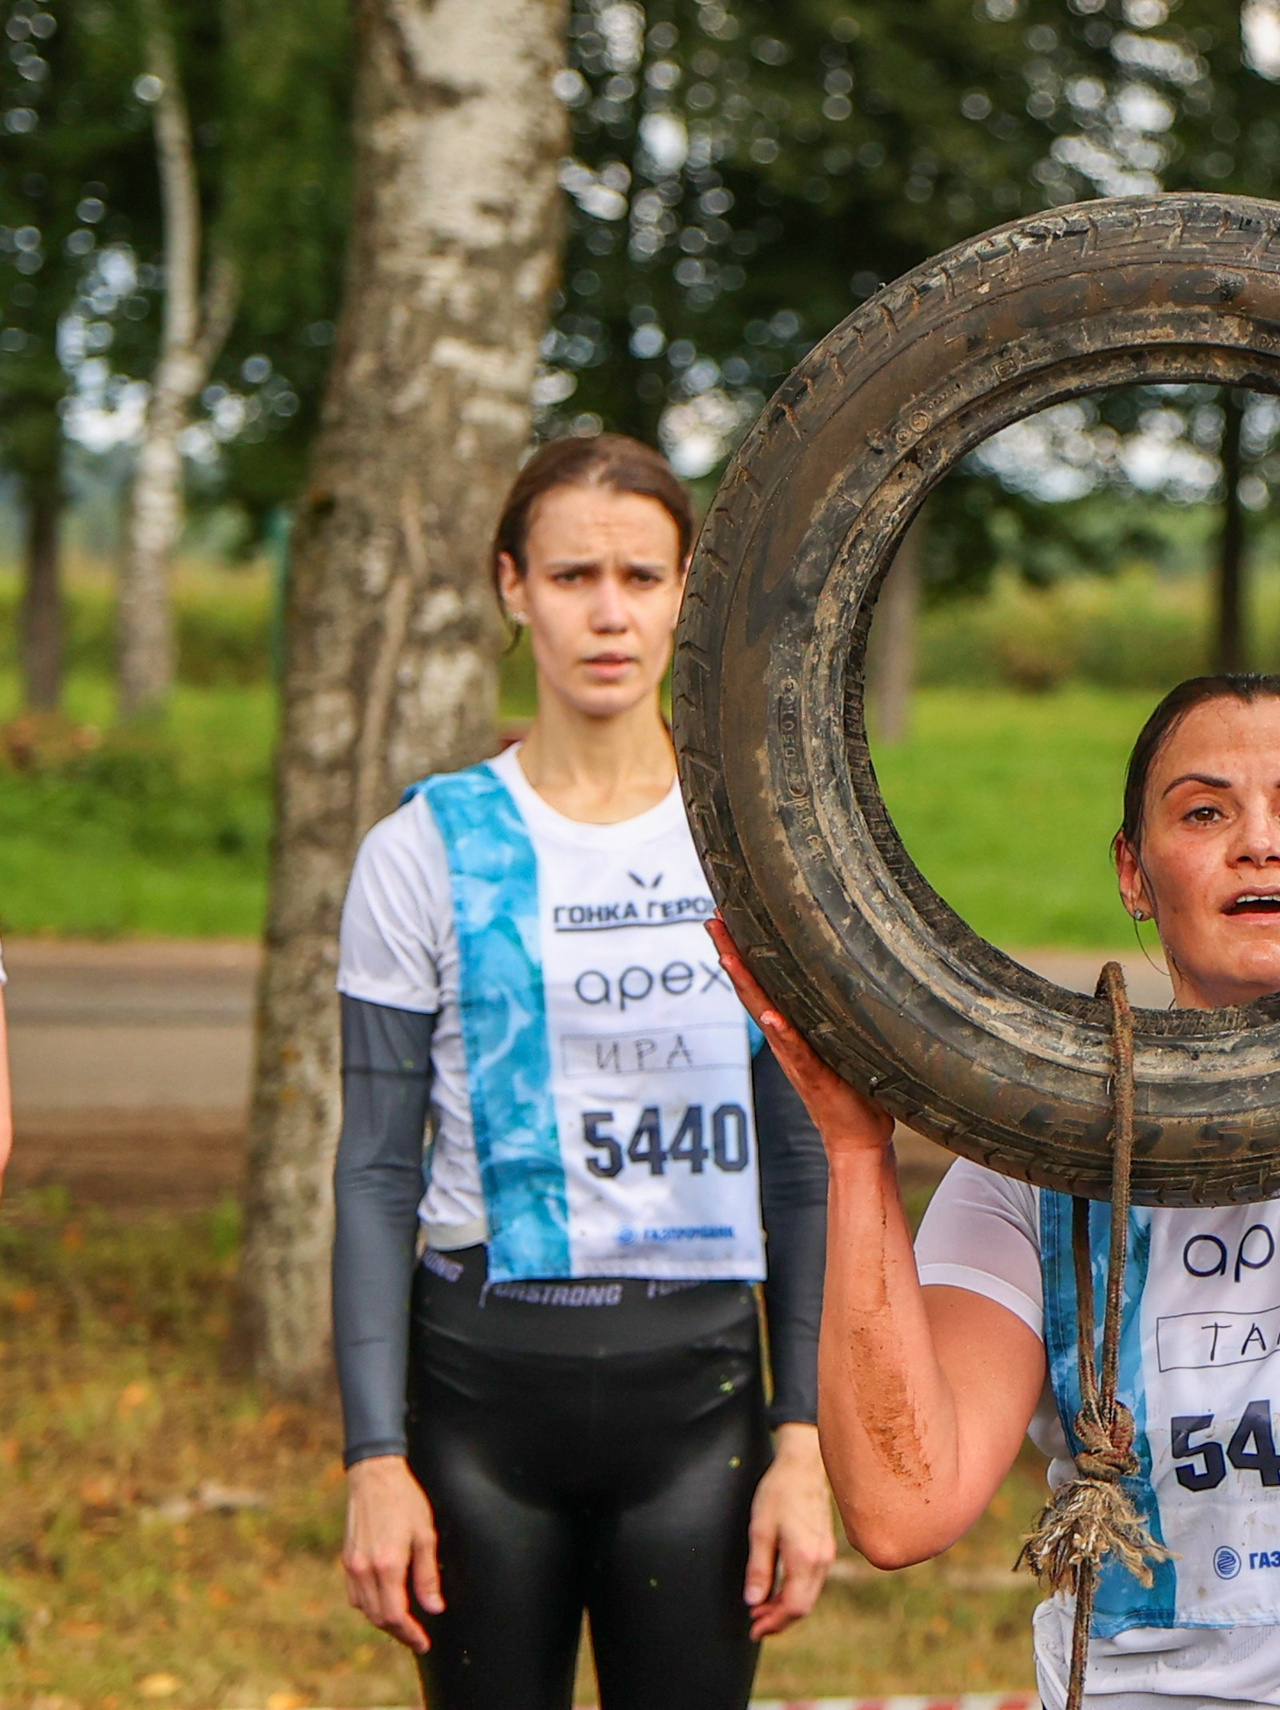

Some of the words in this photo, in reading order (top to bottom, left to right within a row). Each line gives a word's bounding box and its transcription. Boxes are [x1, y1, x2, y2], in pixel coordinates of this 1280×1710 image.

[554, 902, 638, 924] ГОНКА
[596, 1034, 693, 1073] ИРА
[581, 1103, 749, 1178] 5440
